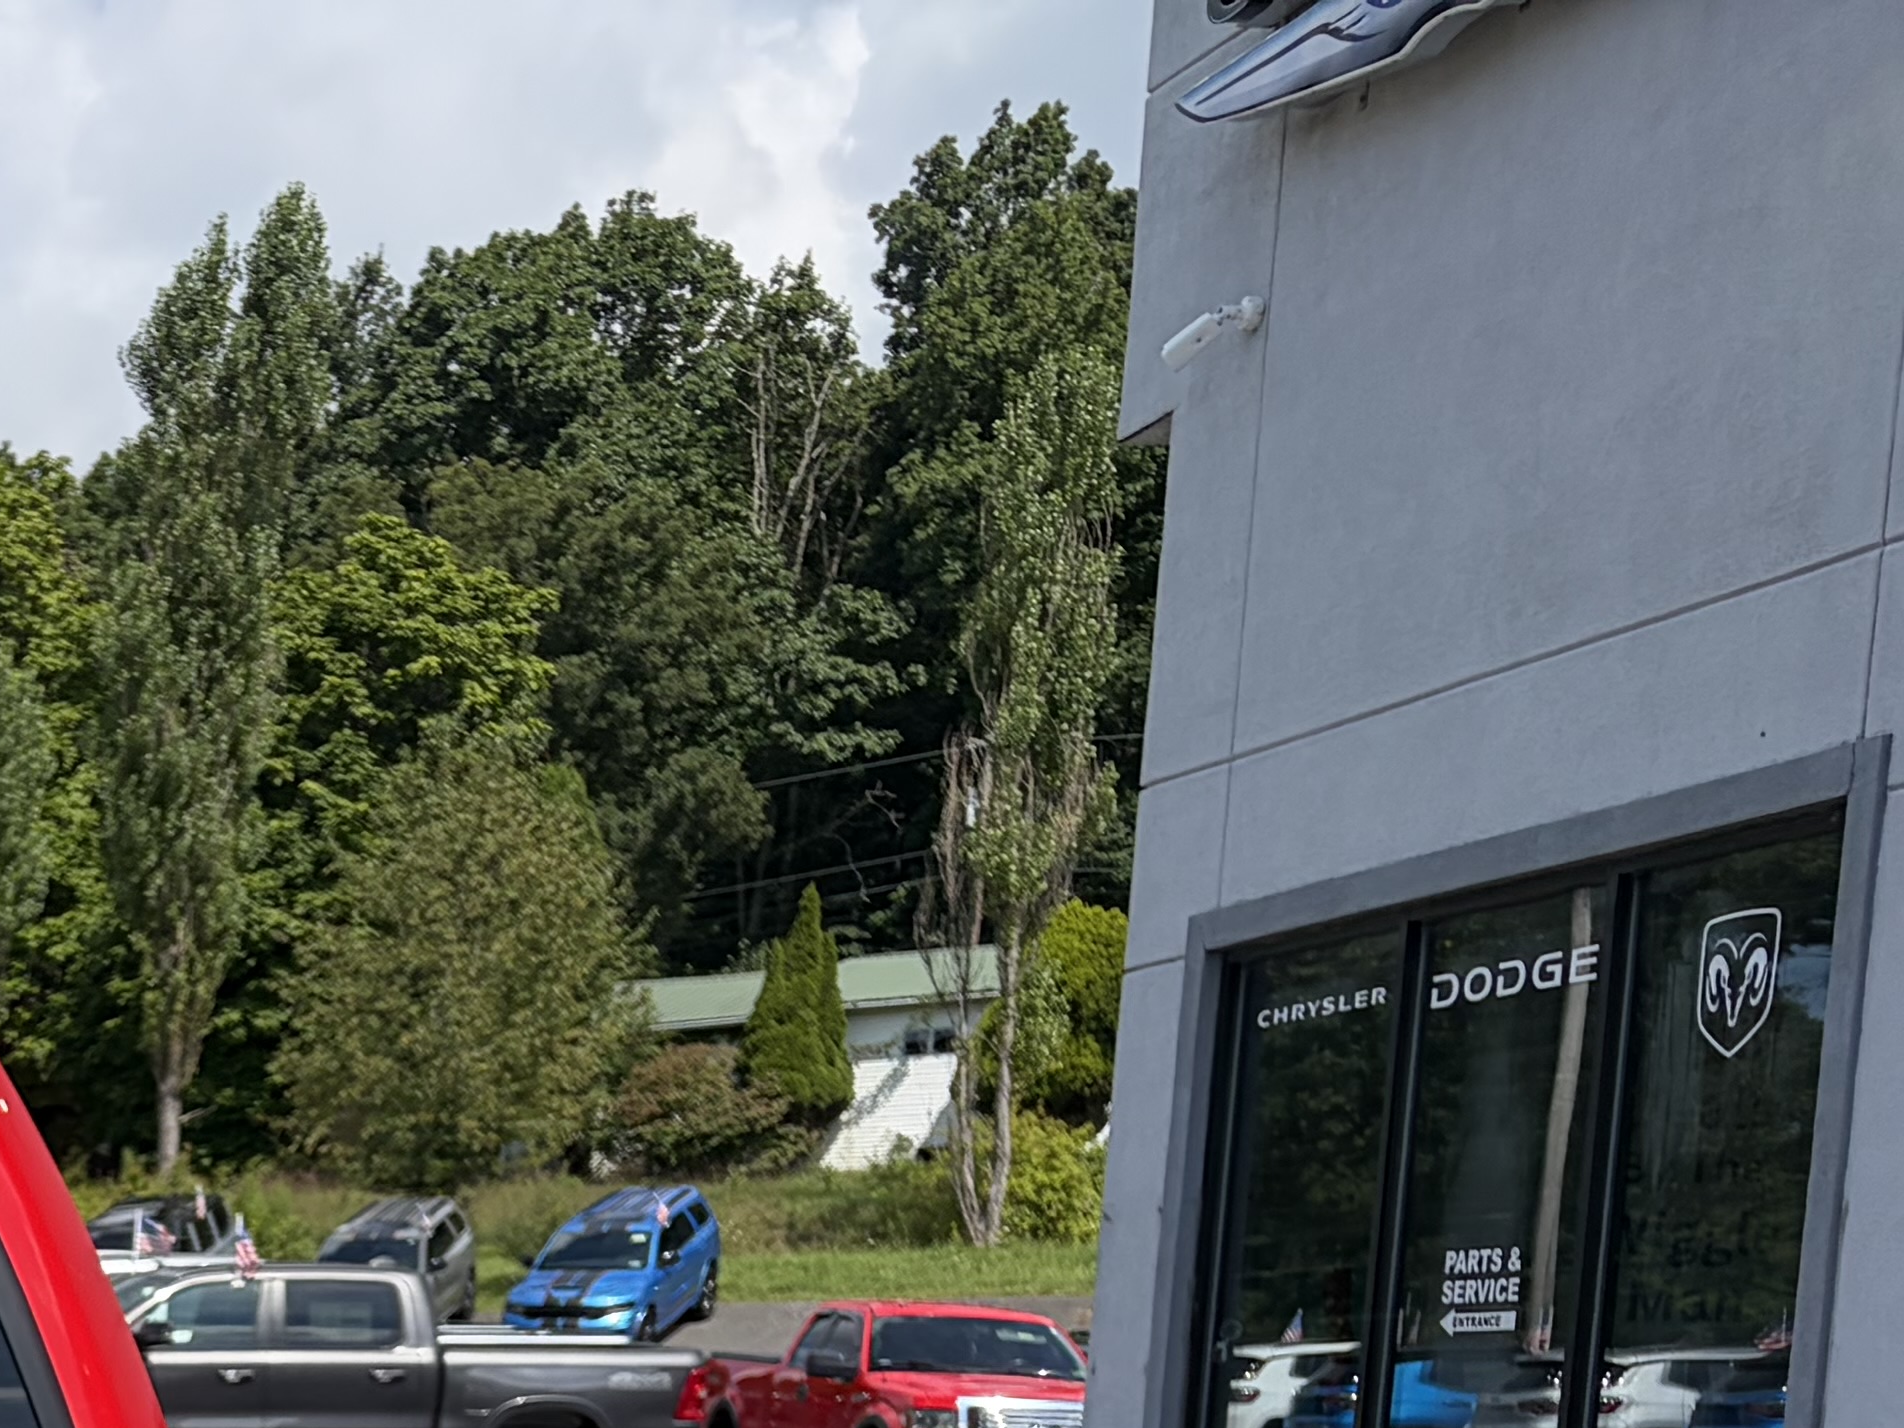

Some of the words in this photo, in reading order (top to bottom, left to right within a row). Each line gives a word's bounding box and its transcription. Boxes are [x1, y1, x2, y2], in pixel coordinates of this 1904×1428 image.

[1429, 944, 1600, 1010] DODGE
[1256, 986, 1388, 1029] CHRYSLER
[1444, 1247, 1503, 1275] PARTS
[1507, 1246, 1522, 1272] &
[1441, 1277, 1521, 1304] SERVICE
